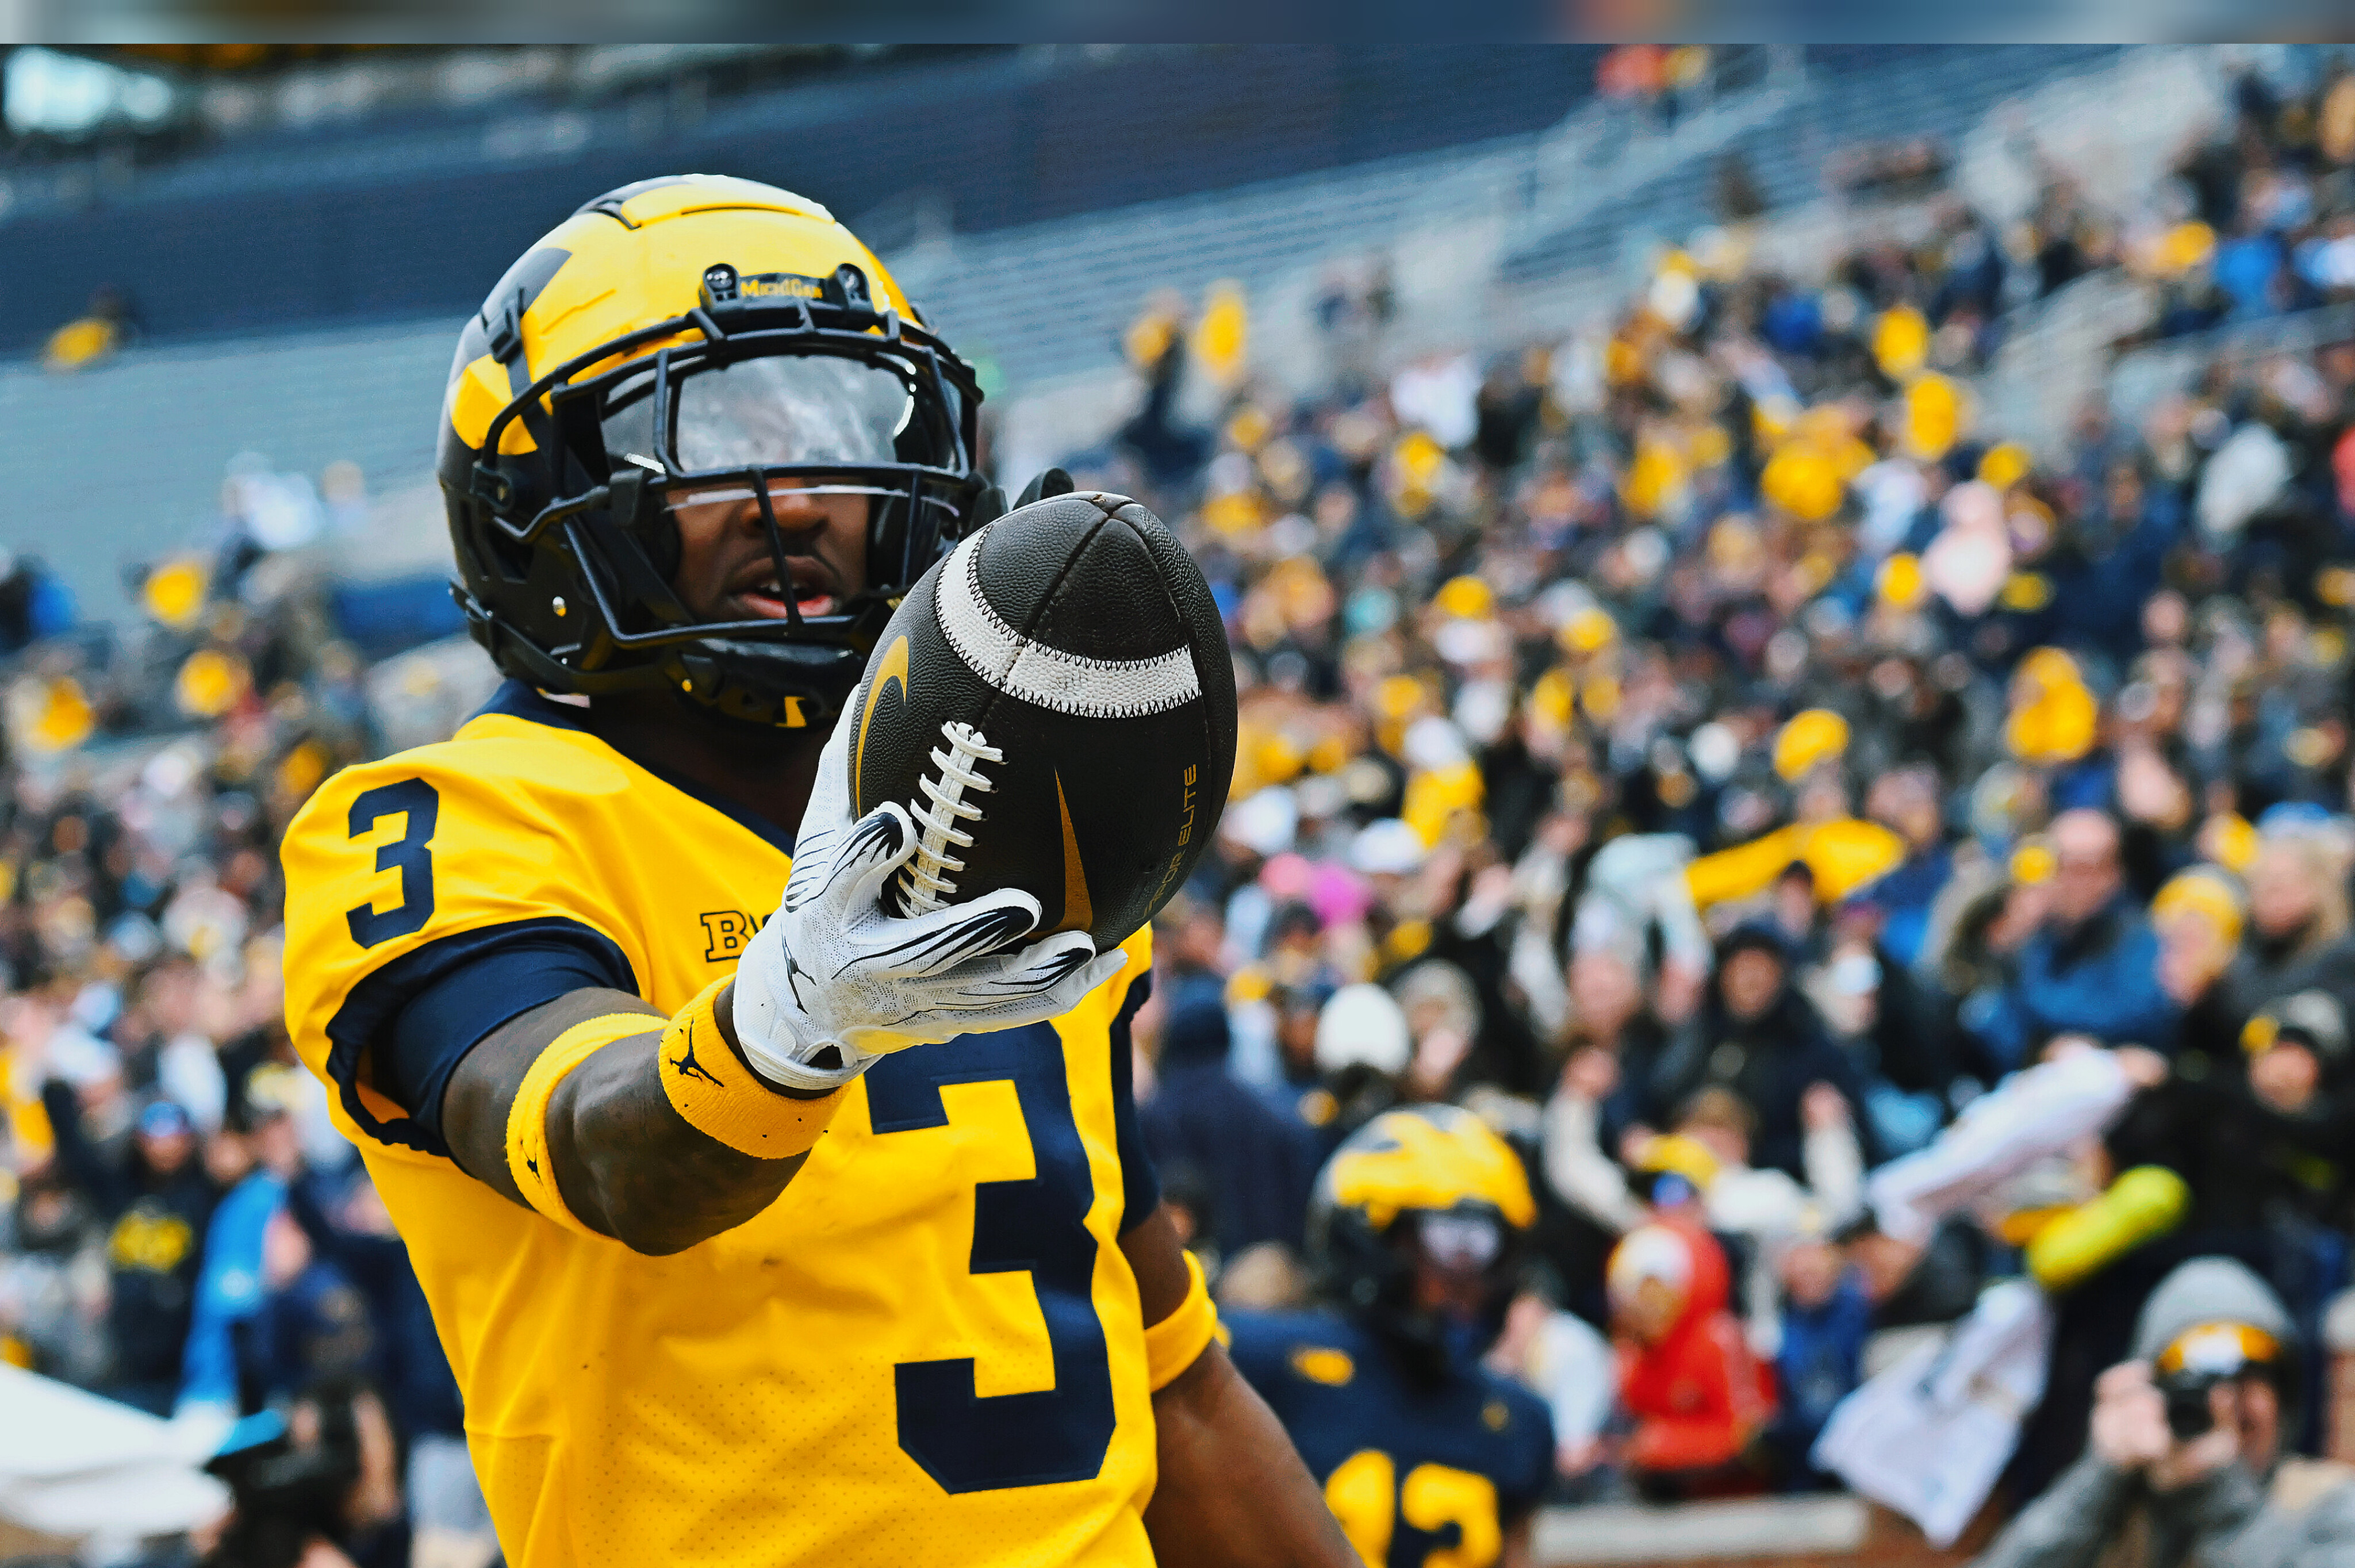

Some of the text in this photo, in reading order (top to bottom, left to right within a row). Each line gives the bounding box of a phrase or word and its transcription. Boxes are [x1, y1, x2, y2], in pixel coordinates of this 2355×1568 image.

[346, 777, 439, 949] 3
[1178, 764, 1197, 846] ELITE
[864, 1019, 1117, 1495] 3
